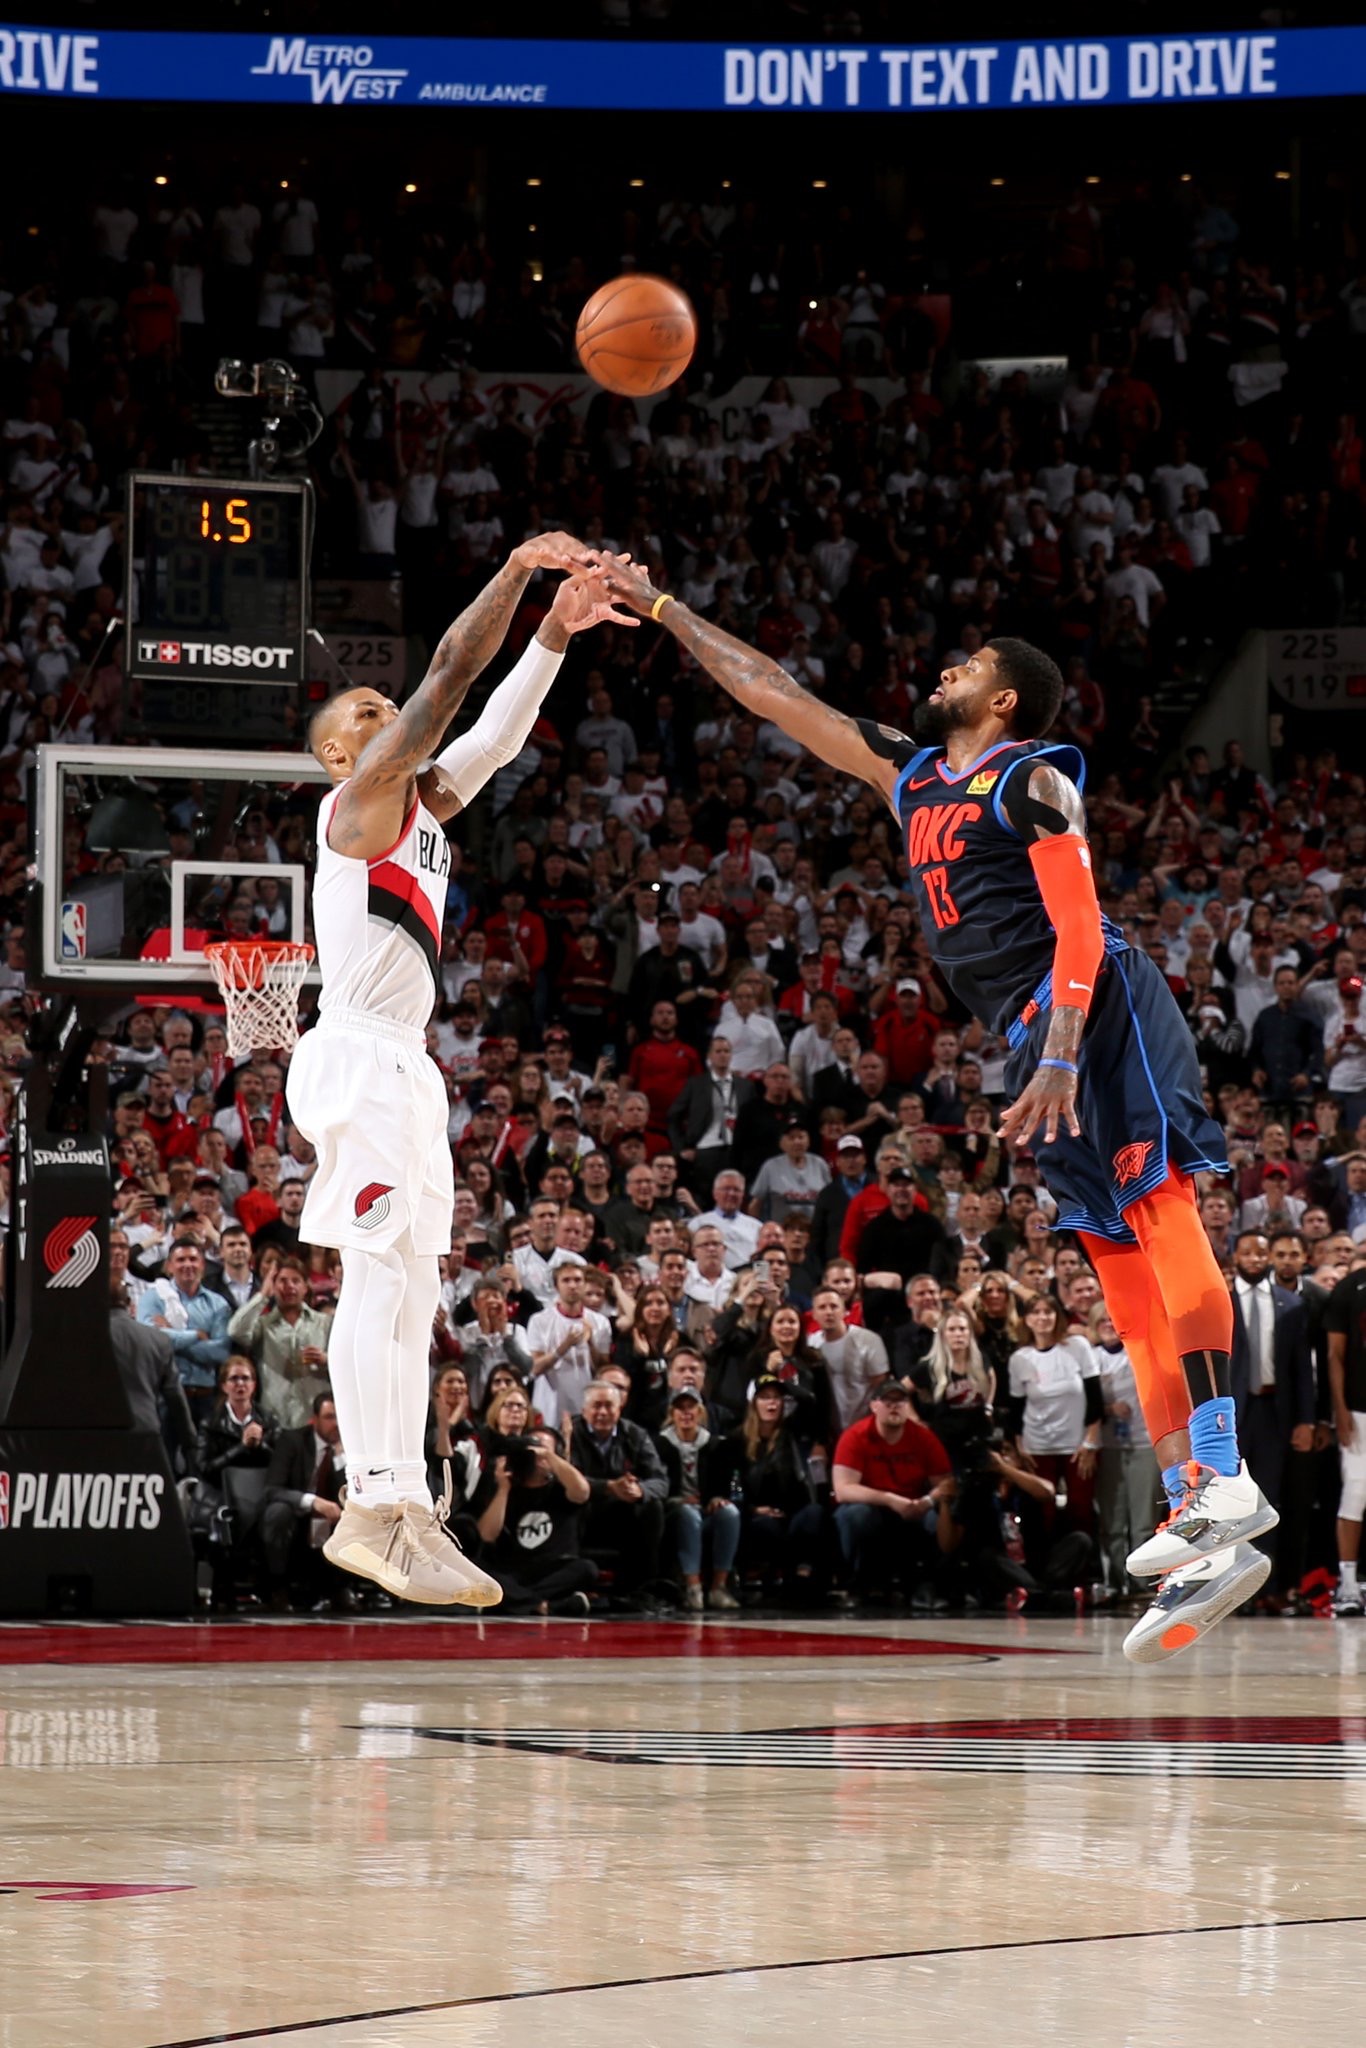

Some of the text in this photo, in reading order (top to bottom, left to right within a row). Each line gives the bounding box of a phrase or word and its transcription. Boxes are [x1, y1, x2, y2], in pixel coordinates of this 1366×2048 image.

[265, 37, 373, 74] METRO
[310, 68, 402, 104] WEST
[725, 37, 1276, 106] DON'T TEXT AND DRIVE
[419, 83, 547, 102] AMBULANCE
[201, 499, 250, 543] 1.5
[182, 643, 293, 668] TISSOT
[338, 641, 392, 666] 225
[1281, 634, 1338, 659] 225
[1283, 674, 1339, 699] 119
[909, 803, 982, 868] OKC
[922, 866, 960, 930] 13
[33, 1148, 104, 1166] SPALDING
[11, 1472, 165, 1530] PLAYOFFS
[519, 1520, 551, 1539] TNT
